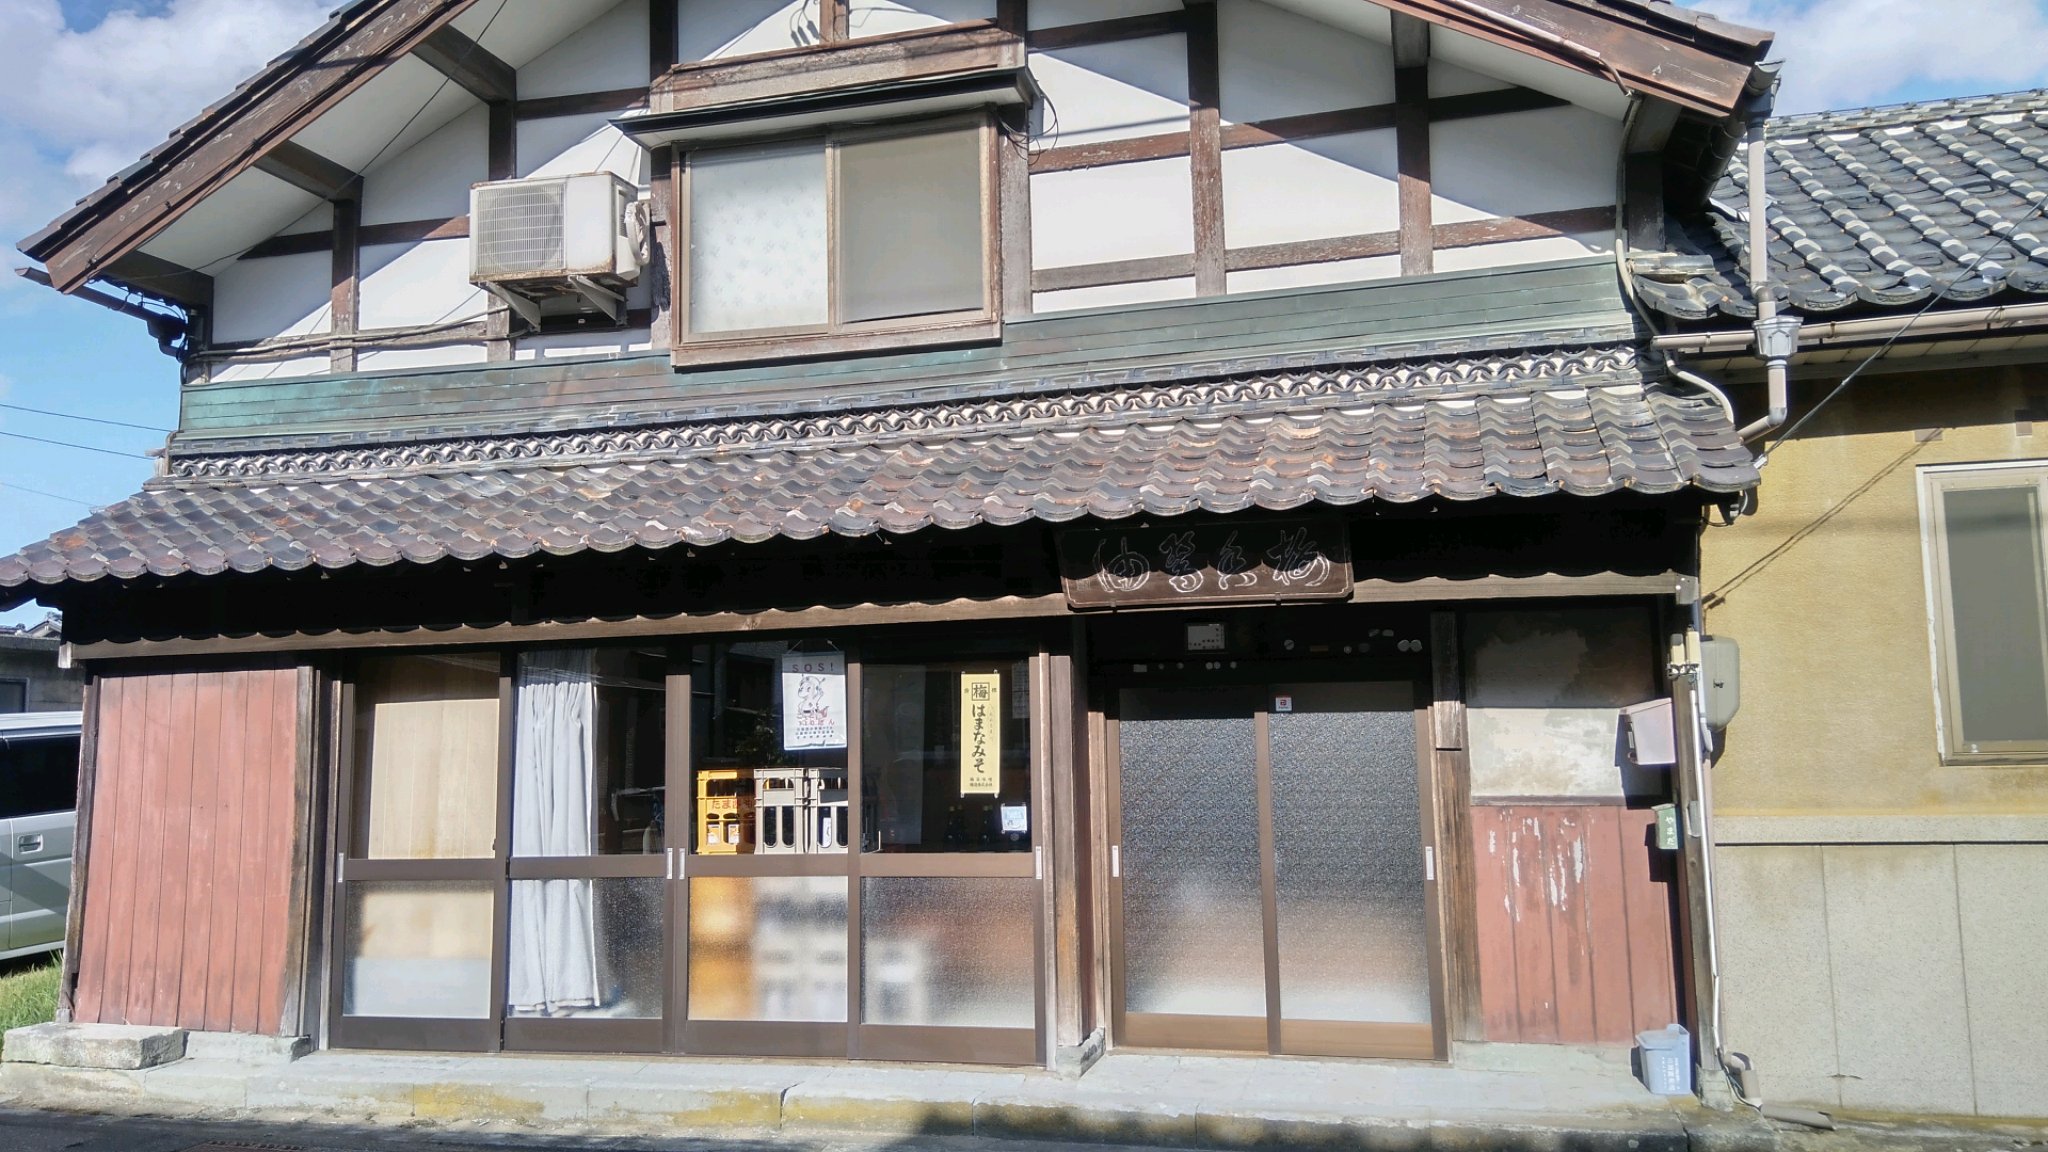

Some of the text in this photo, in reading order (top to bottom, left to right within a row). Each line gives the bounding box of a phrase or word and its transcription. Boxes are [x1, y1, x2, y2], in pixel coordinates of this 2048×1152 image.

[972, 684, 988, 699] 梅
[971, 703, 987, 774] はまなみそ
